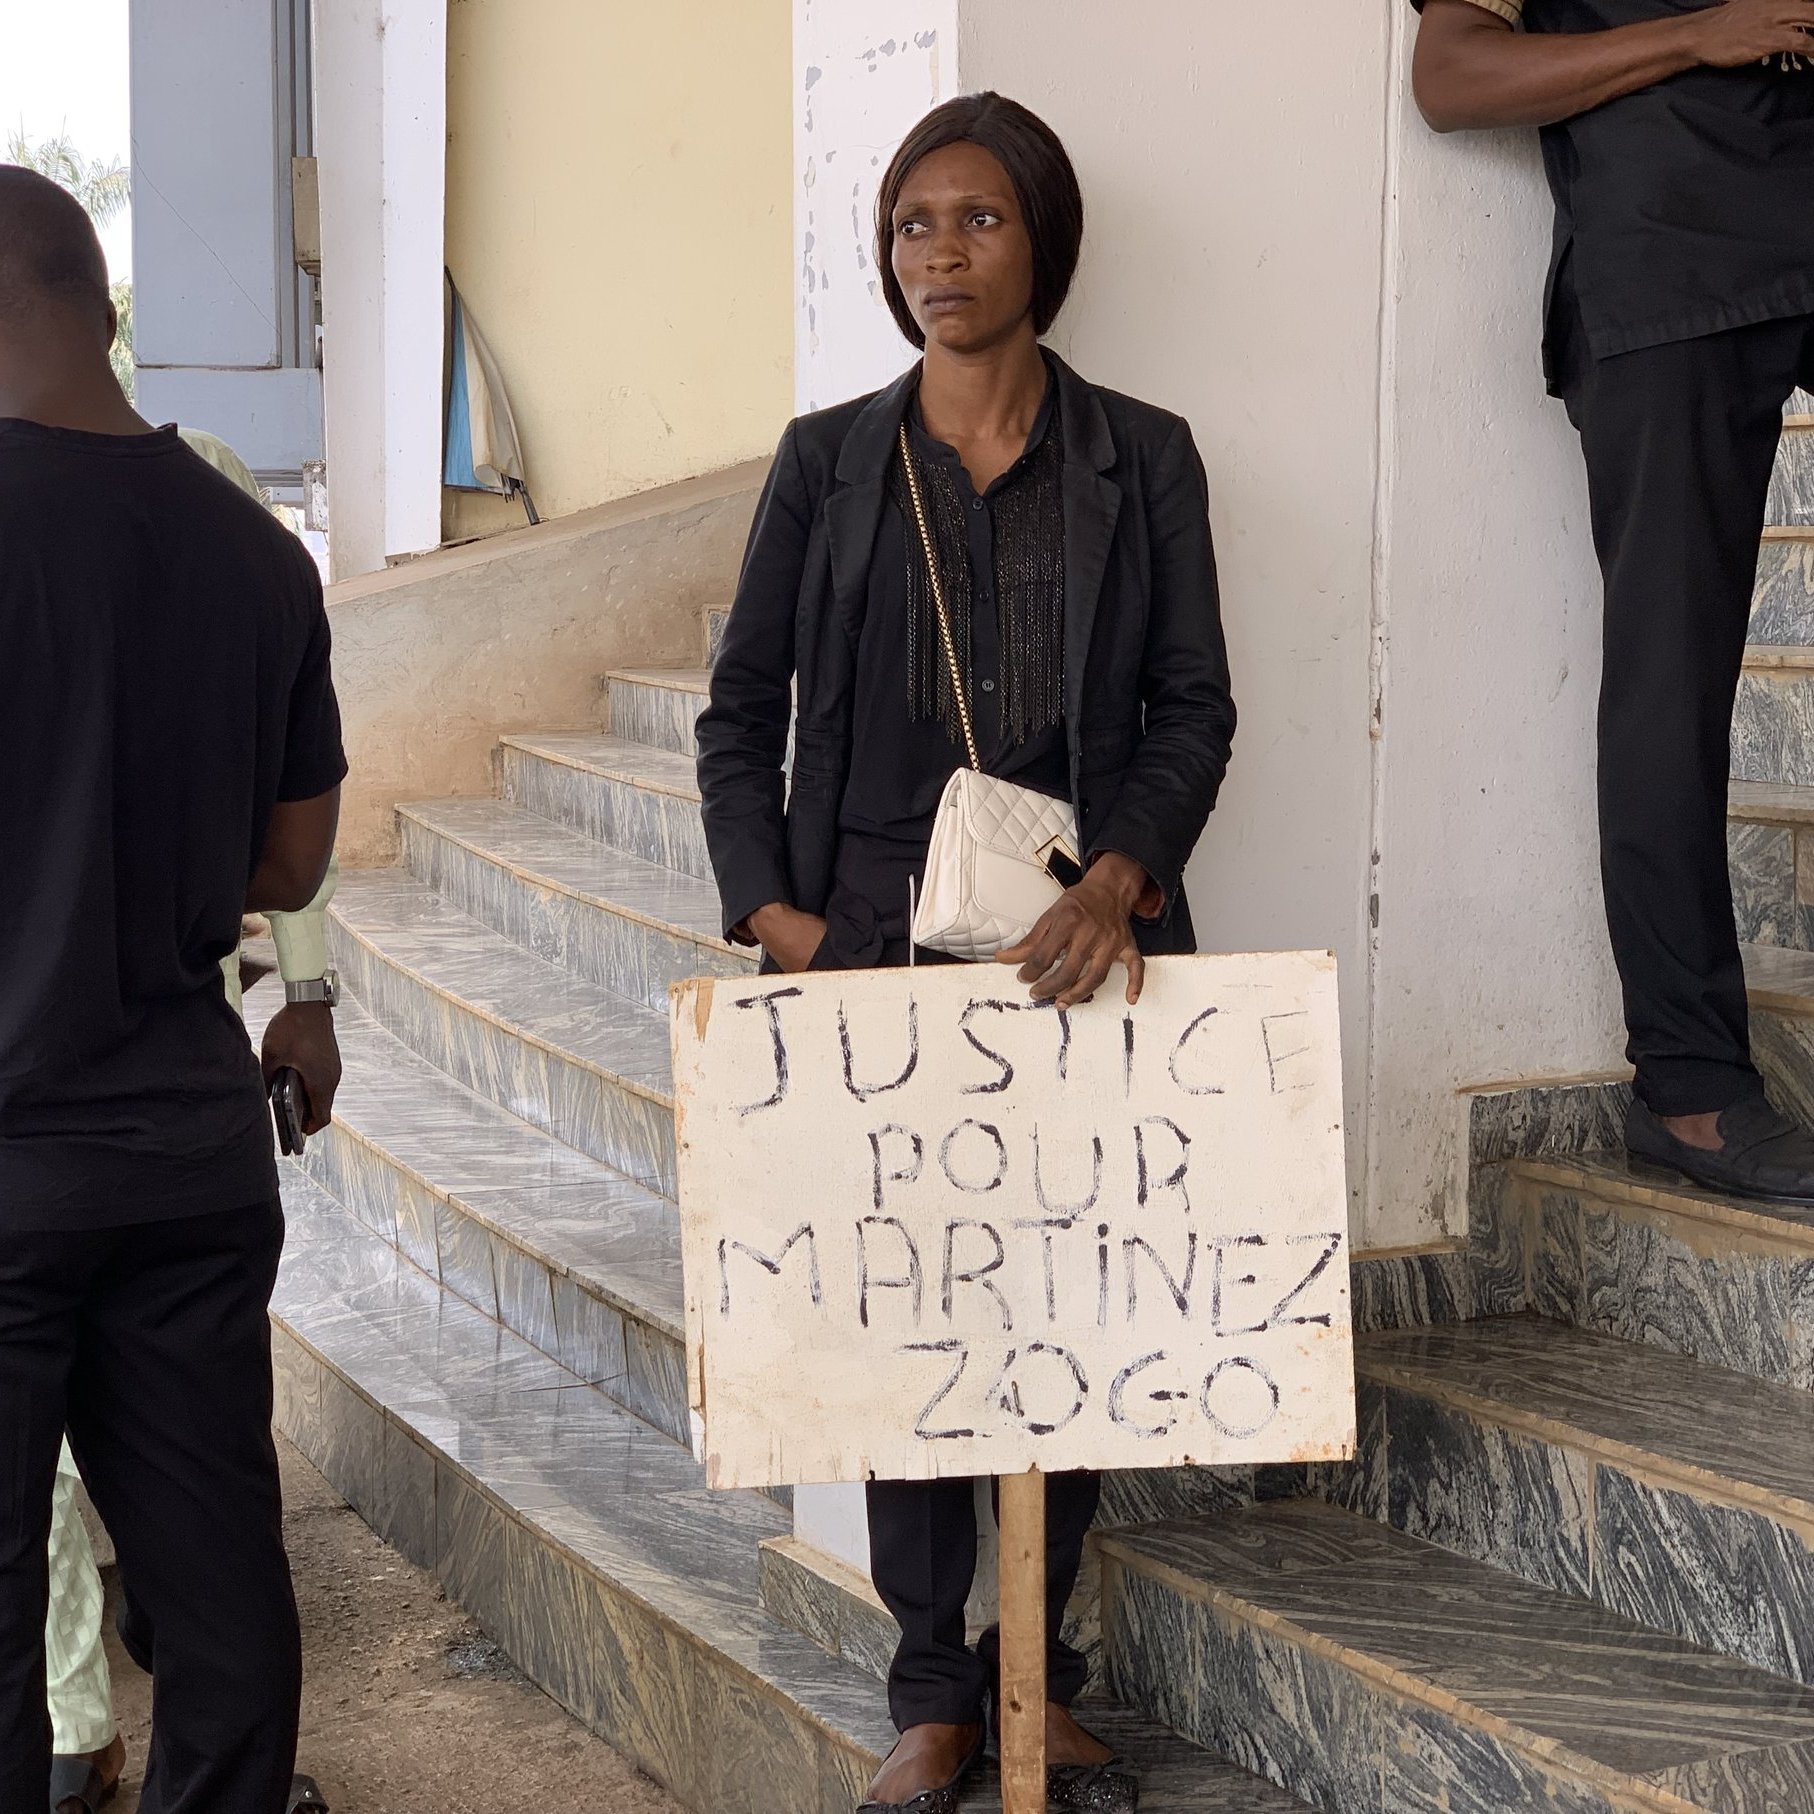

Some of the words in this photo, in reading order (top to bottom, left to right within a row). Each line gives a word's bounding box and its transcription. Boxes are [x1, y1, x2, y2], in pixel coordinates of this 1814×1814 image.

[732, 987, 1315, 1116] JUSTICE
[868, 1116, 1192, 1218] POUR
[898, 1340, 1280, 1439] ZOGO
